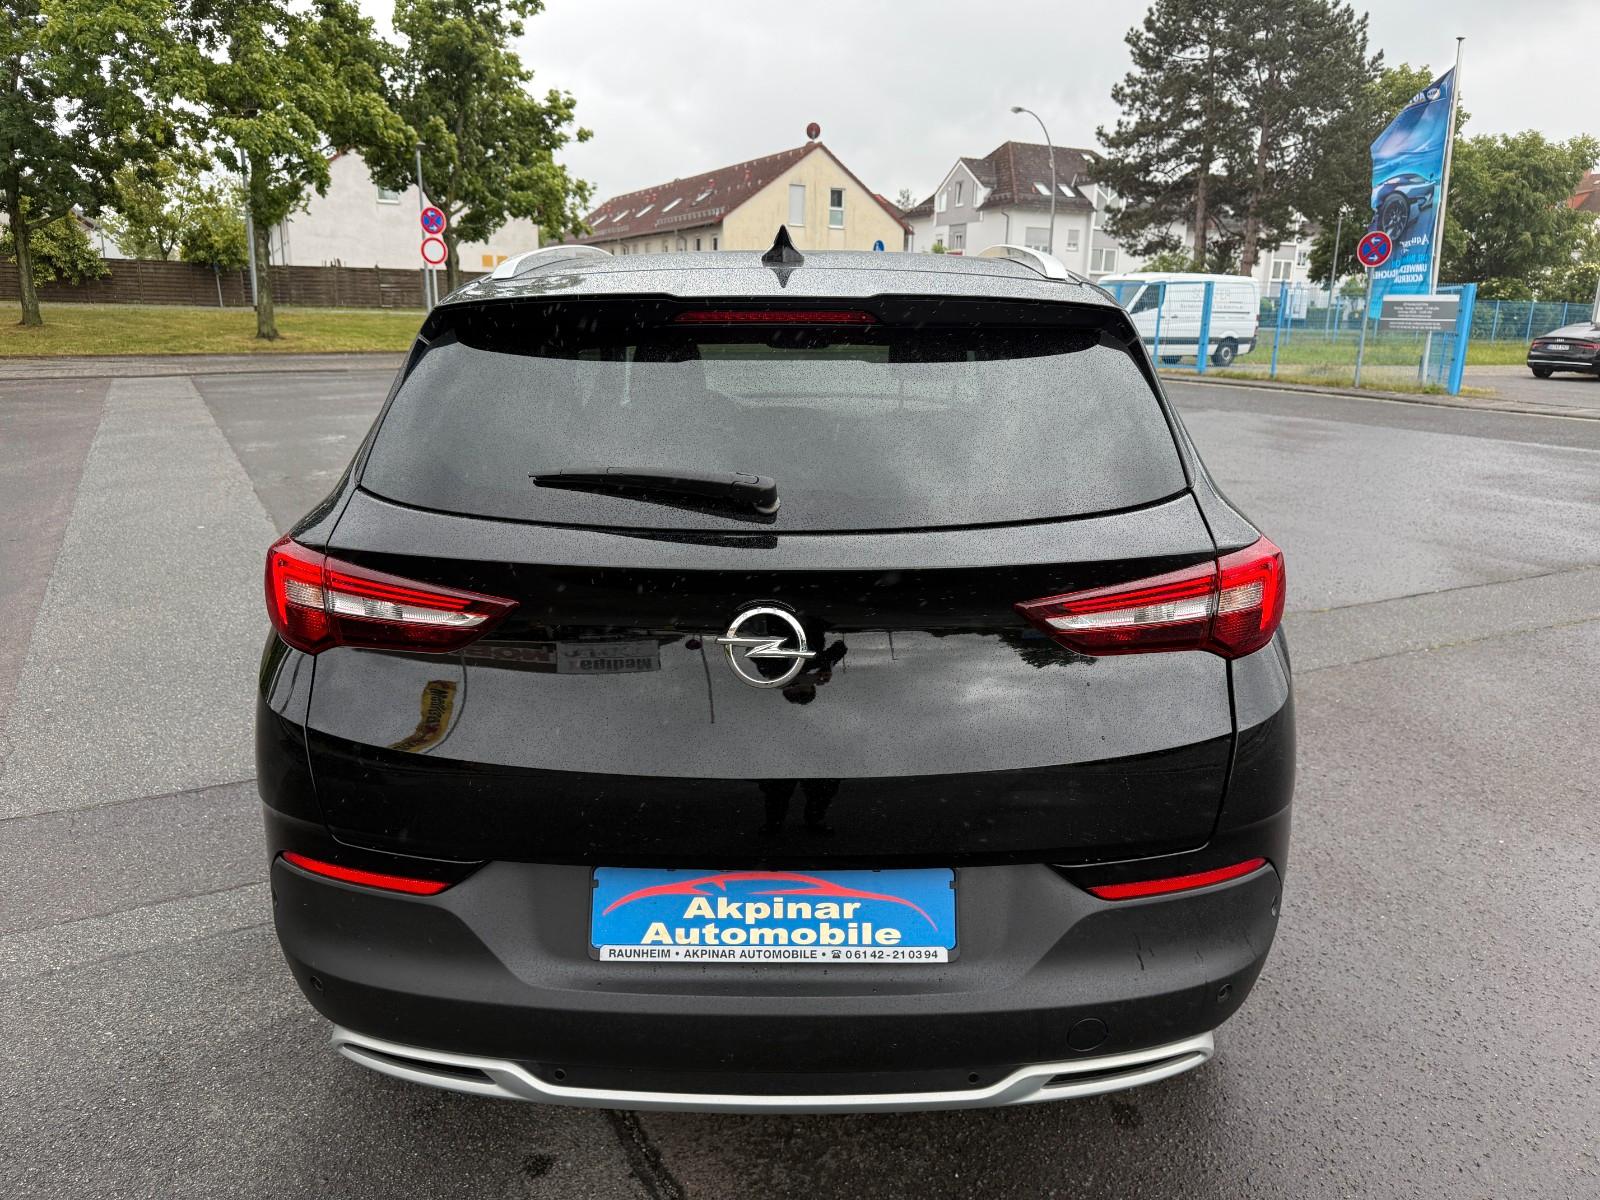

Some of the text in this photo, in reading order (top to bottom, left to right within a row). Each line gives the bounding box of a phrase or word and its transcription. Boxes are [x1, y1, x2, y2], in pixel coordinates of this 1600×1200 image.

[683, 896, 862, 925] Akpinar
[640, 922, 902, 945] Automobile
[608, 948, 671, 959] RAUNHEIM
[684, 949, 736, 959] AKPINAR
[739, 949, 818, 960] AUTOMOBILE
